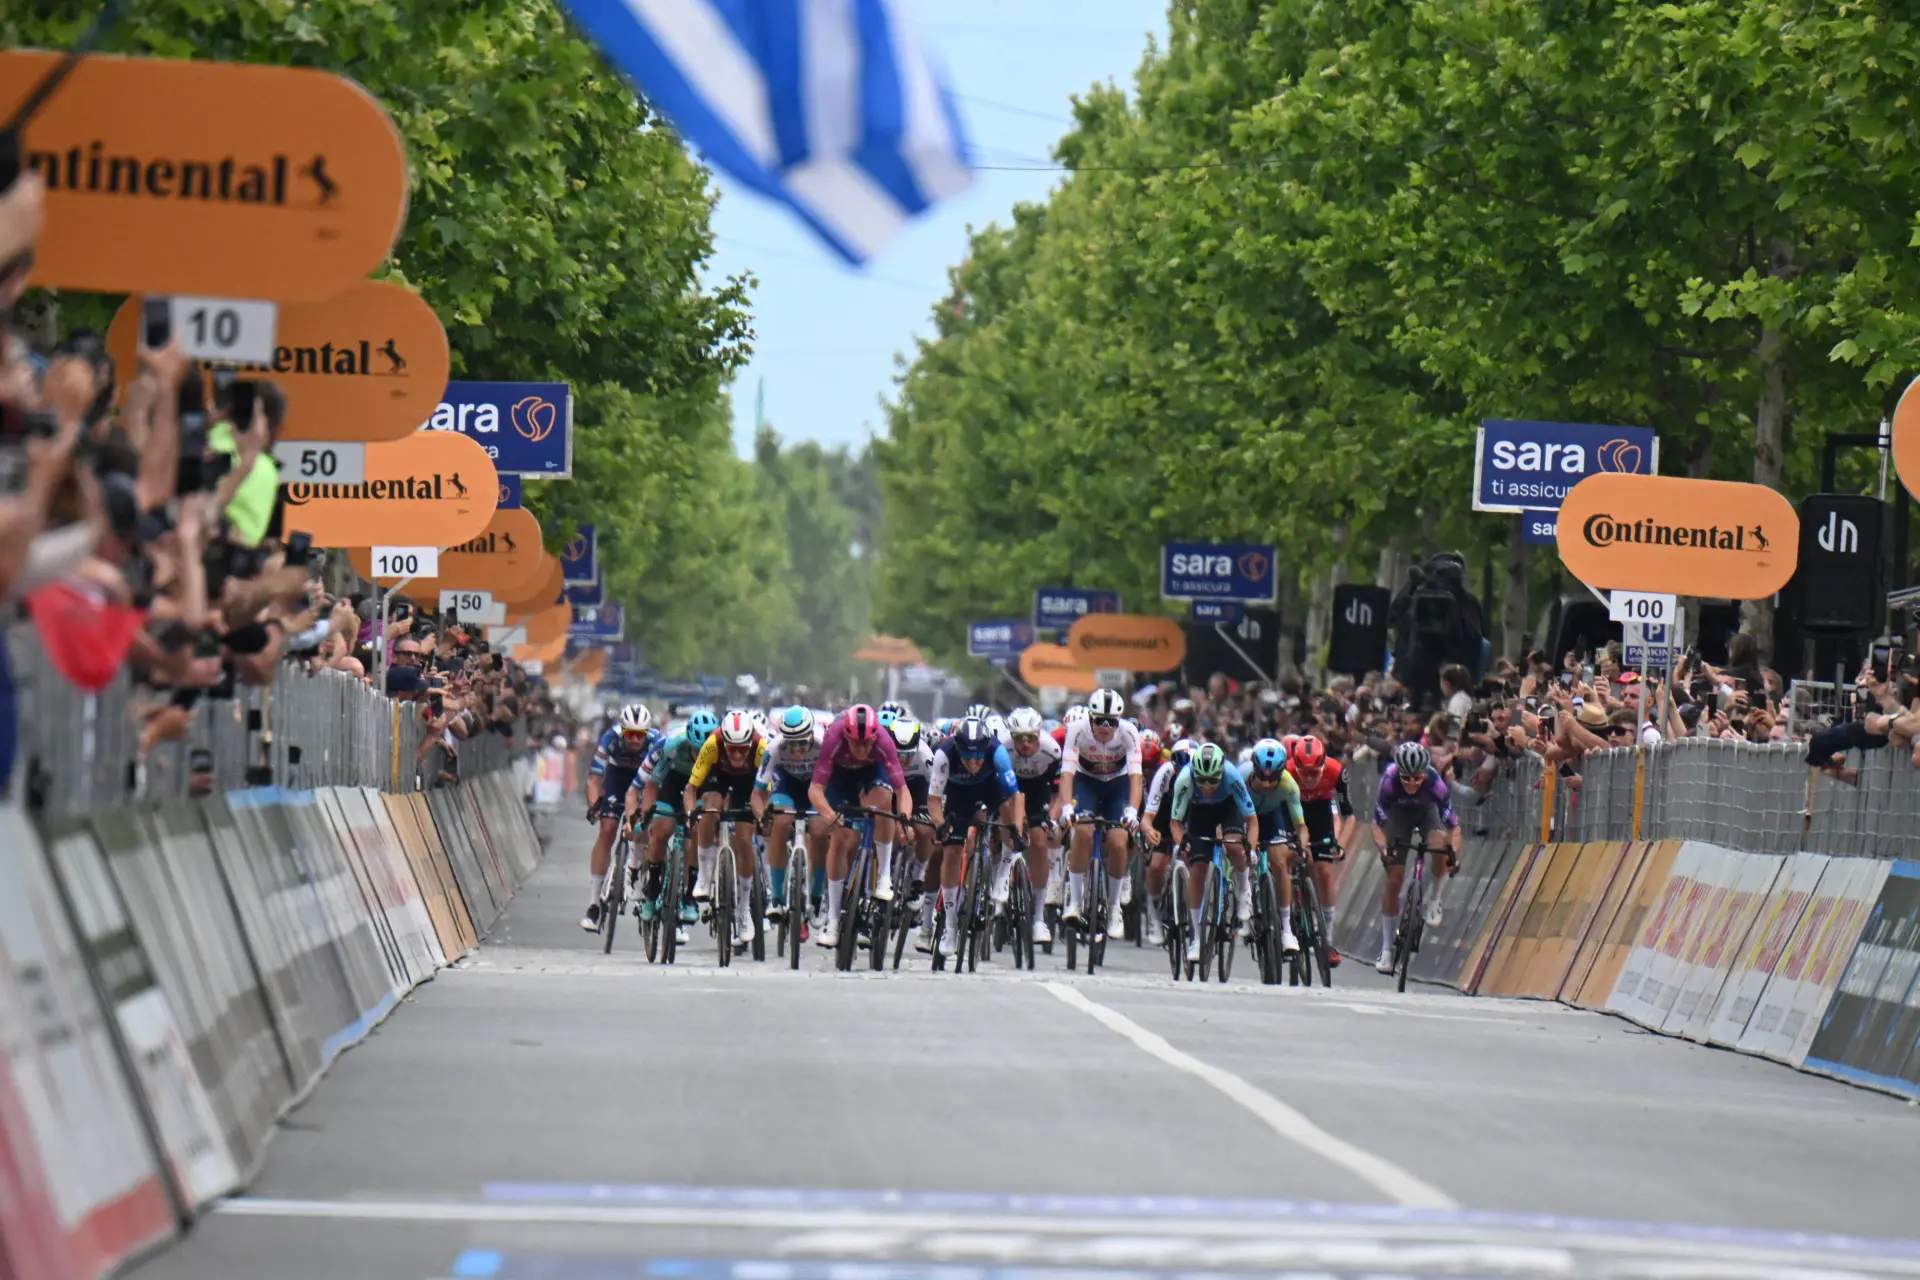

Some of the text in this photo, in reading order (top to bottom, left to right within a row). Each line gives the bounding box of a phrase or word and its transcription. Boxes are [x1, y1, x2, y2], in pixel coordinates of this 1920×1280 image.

[28, 141, 287, 204] ntinental
[190, 308, 241, 347] 10
[418, 402, 499, 433] ara
[301, 449, 337, 476] 50
[1492, 440, 1585, 473] sara
[1492, 479, 1575, 499] ti assicur
[1583, 513, 1744, 550] Continental
[378, 555, 418, 574] 100
[1172, 553, 1232, 576] sara
[450, 594, 482, 610] 150
[1624, 599, 1664, 618] 100
[1648, 624, 1661, 640] P
